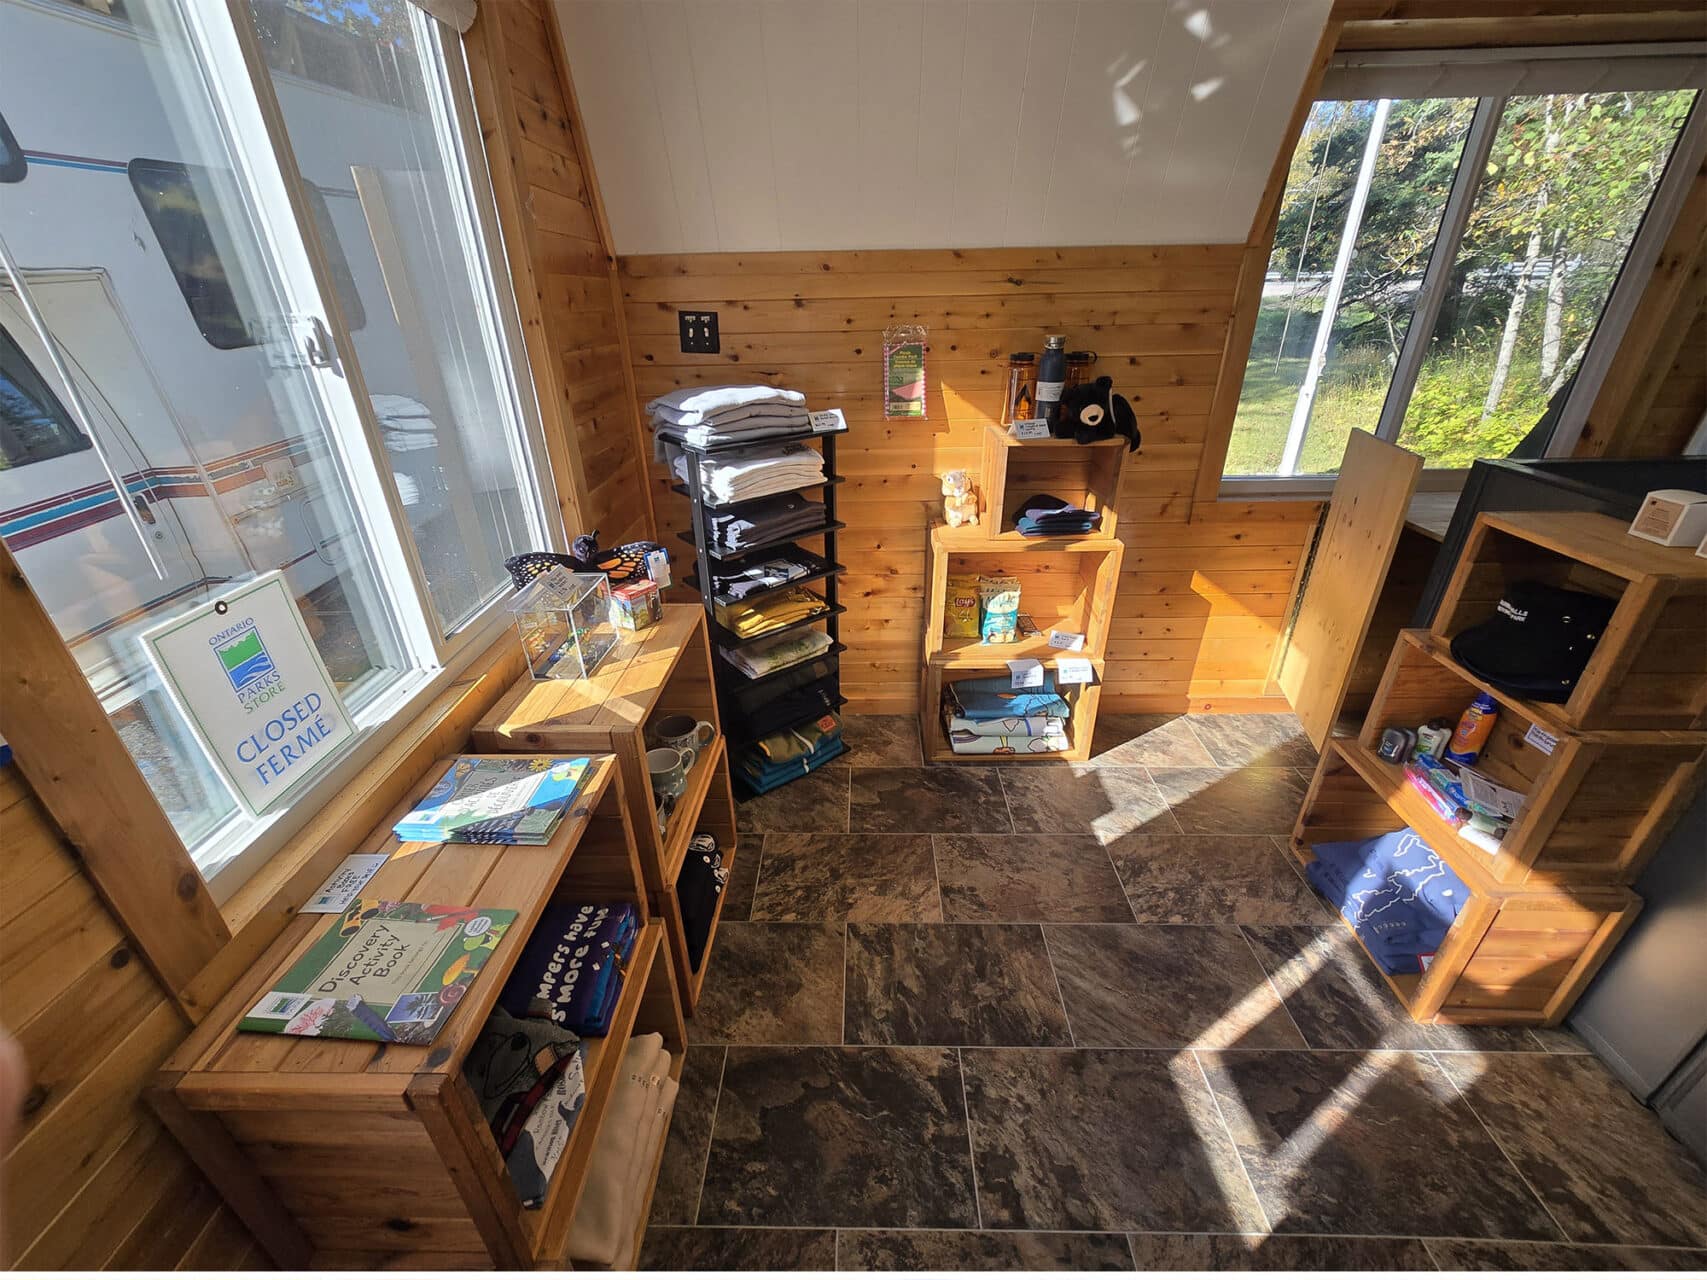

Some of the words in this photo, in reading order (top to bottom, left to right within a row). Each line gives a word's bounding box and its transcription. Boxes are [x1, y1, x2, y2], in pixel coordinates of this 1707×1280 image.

[208, 617, 254, 646] ONTARIO
[237, 671, 281, 703] PARKS
[244, 682, 286, 714] STORE
[235, 692, 322, 764] CLOSED
[255, 714, 331, 786] FERMÉ
[564, 904, 593, 942] have
[318, 923, 391, 994] Discovery
[350, 934, 401, 986] Activity
[373, 943, 410, 979] Book
